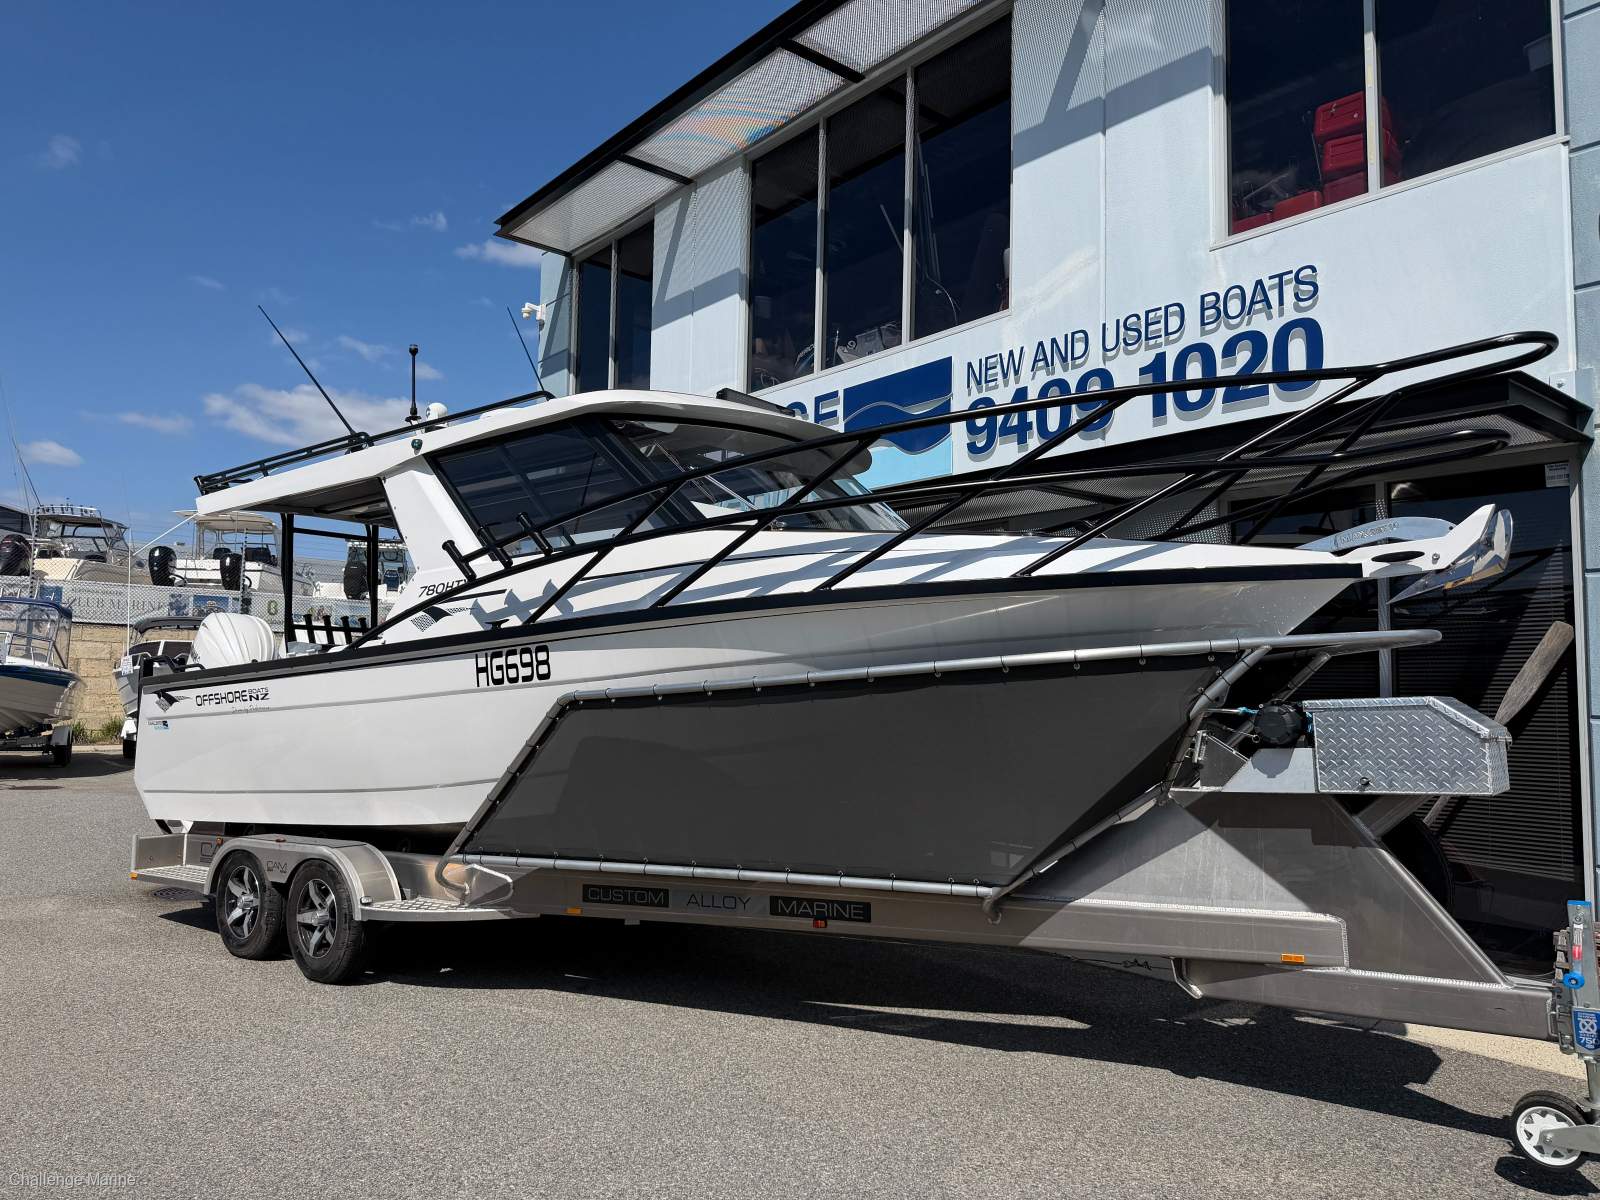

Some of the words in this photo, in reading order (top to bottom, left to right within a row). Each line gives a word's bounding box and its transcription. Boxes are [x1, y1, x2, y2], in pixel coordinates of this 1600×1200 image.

[966, 346, 1025, 389] NEW
[1031, 329, 1089, 373] AND
[1102, 302, 1186, 353] USED
[1199, 265, 1320, 328] BOATS
[1138, 317, 1325, 418] 1020
[418, 578, 468, 598] 780HT
[475, 644, 551, 687] HG698
[195, 690, 248, 707] OFFSHORE
[248, 687, 269, 695] BOATS
[248, 692, 271, 702] NZ
[588, 887, 664, 905] CUSTOM
[686, 893, 751, 911] ALLOY
[778, 901, 864, 920] MARINE
